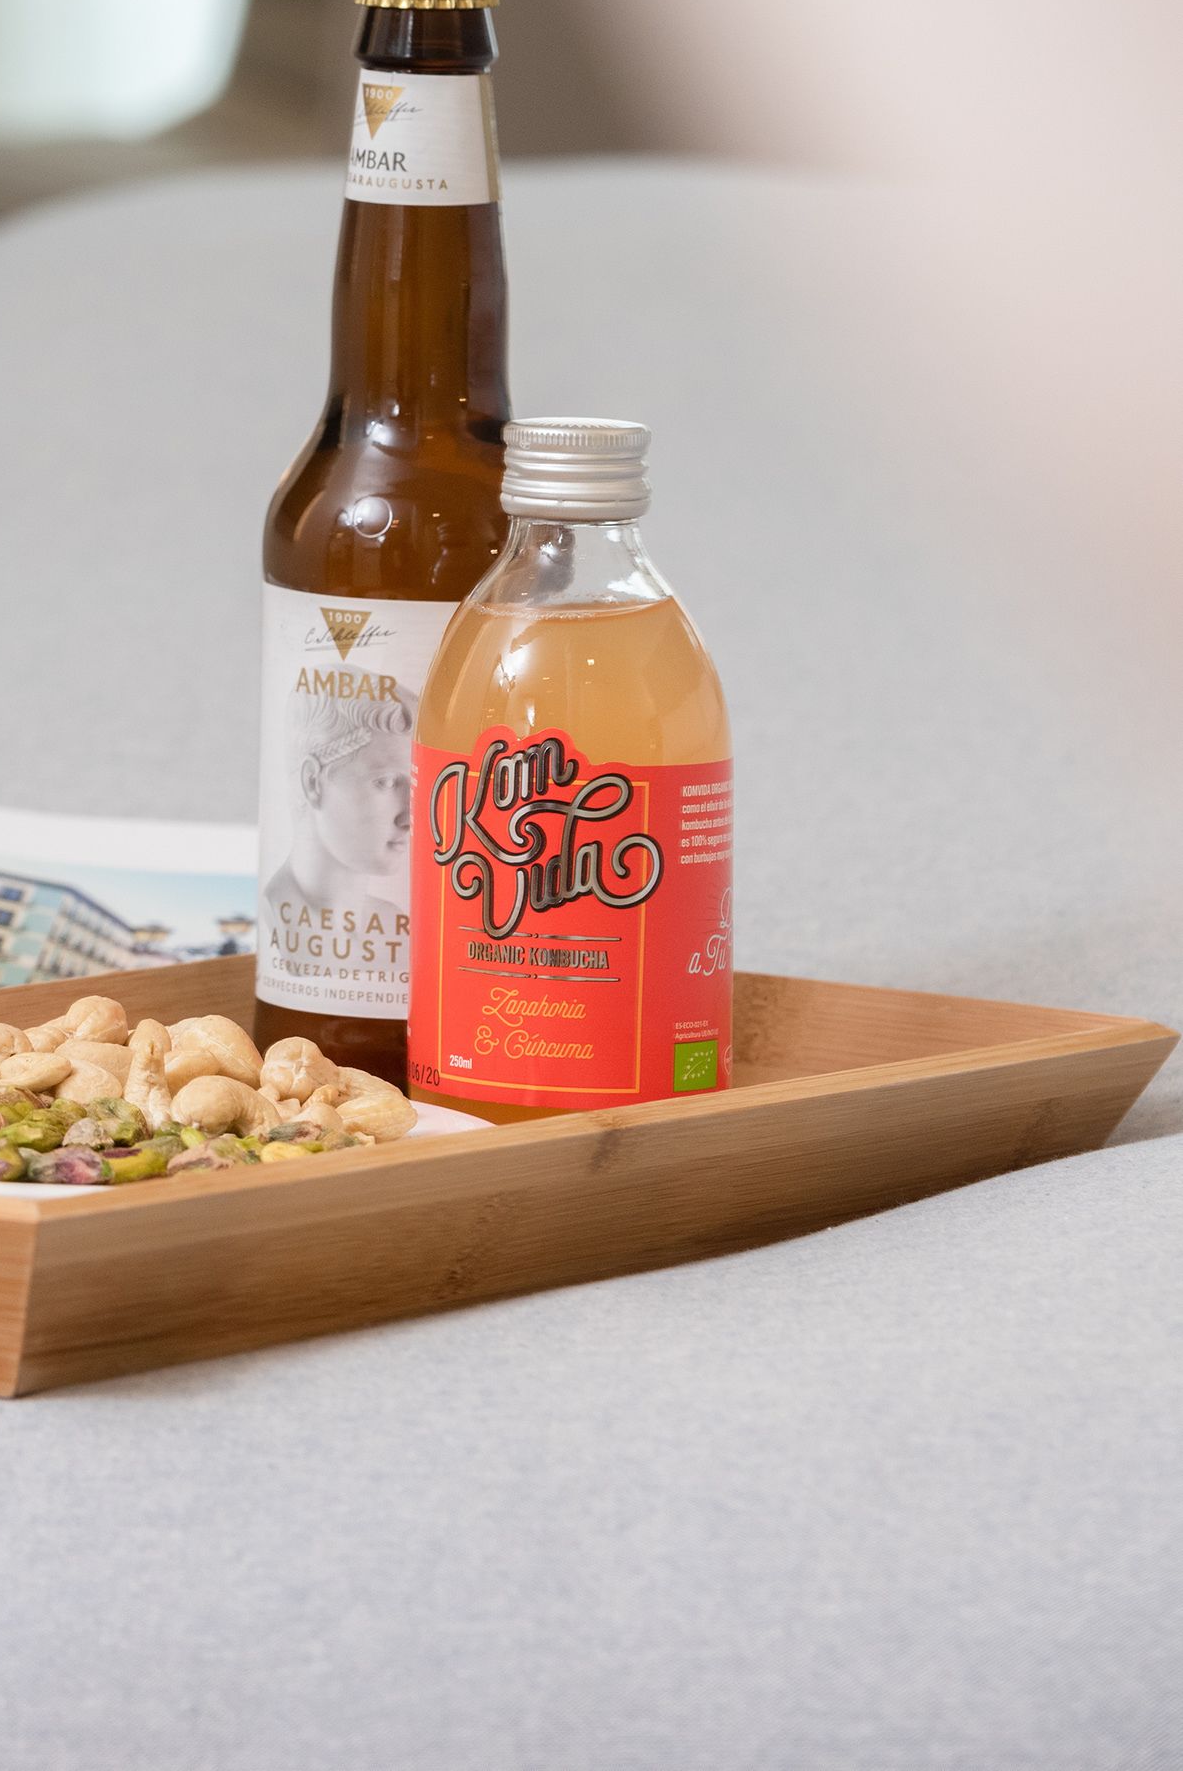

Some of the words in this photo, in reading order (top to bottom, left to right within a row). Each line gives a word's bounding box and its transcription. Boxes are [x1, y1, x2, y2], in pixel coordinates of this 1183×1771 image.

[365, 87, 394, 100] 1900
[329, 611, 362, 624] 1900
[295, 666, 402, 704] AMBAR
[430, 738, 579, 865] Kom
[691, 835, 707, 846] 100%
[451, 773, 665, 940] Vida
[279, 901, 411, 936] CAESAR
[270, 927, 403, 964] AUGUST
[468, 941, 525, 964] ORGANIC
[528, 947, 609, 969] KOMBUCHA
[272, 957, 333, 979] CERVEZA
[339, 968, 361, 981] DE
[366, 970, 410, 984] TRIG
[324, 988, 409, 1005] INDEPENDIE
[482, 987, 586, 1027] Zanahoria
[474, 1025, 499, 1055] &
[504, 1029, 594, 1059] Cúrcuma
[449, 1054, 473, 1069] 250ml
